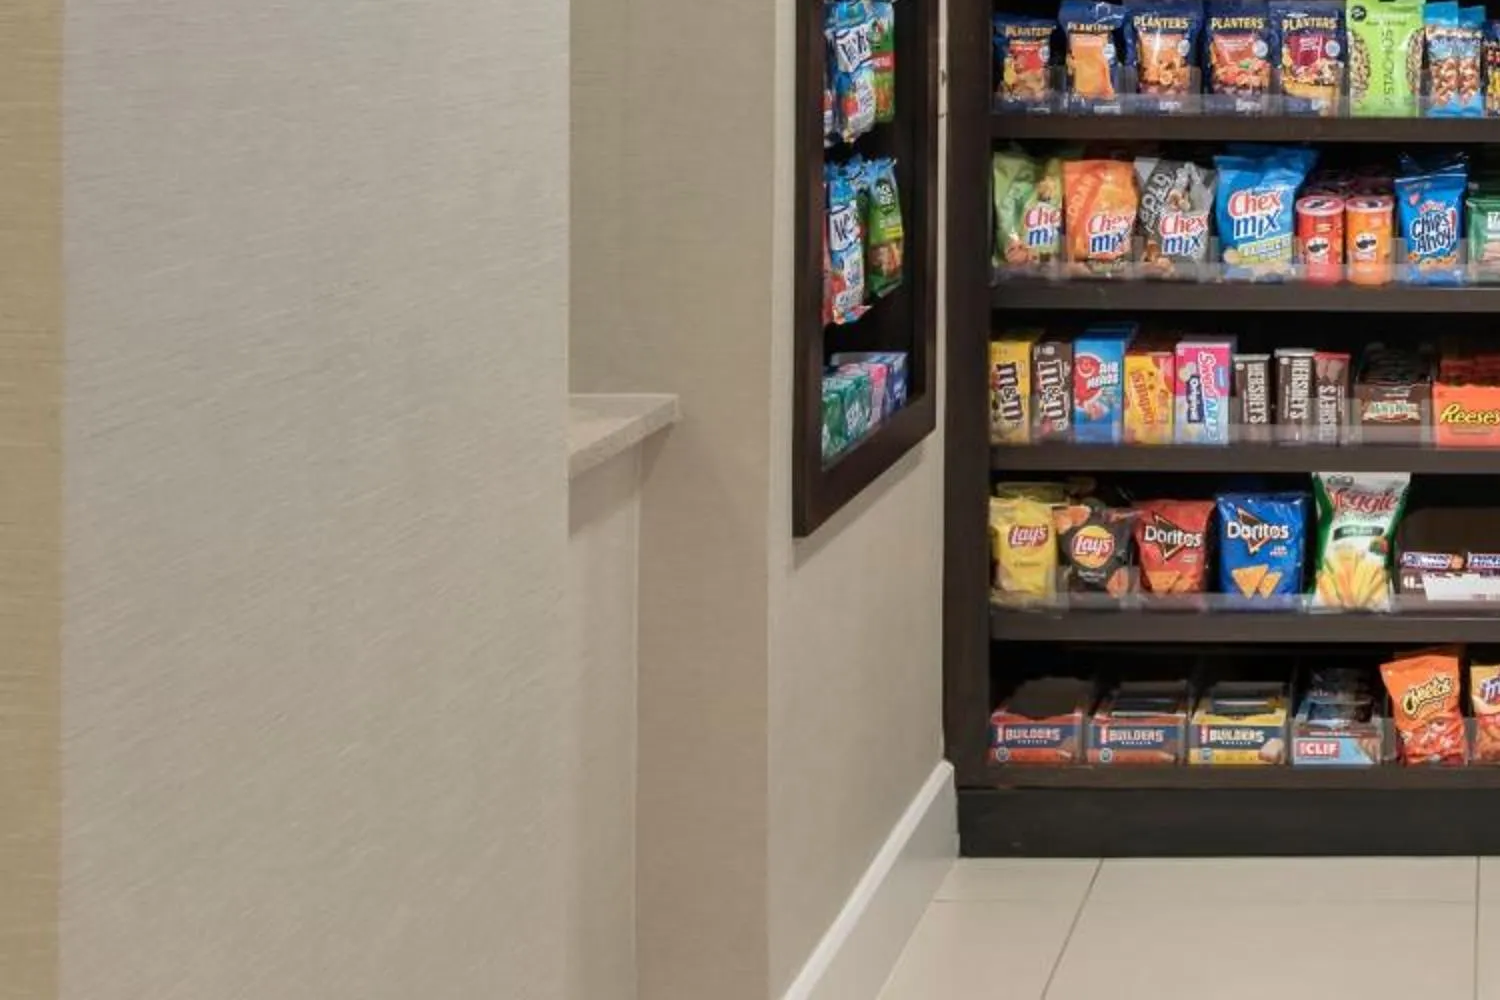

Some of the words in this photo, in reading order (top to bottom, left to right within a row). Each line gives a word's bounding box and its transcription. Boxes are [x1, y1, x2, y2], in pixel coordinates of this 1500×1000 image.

[1133, 15, 1189, 30] PLANTERS
[1211, 16, 1264, 30] PLANTERS
[1282, 17, 1338, 30] PLANTERS
[1229, 191, 1281, 217] Chex
[1025, 207, 1061, 229] Che
[1088, 214, 1135, 235] Chex
[1160, 213, 1208, 235] Chex
[1234, 210, 1280, 238] mix
[1162, 233, 1201, 255] mix
[1247, 363, 1267, 424] HERSHEY'S
[1290, 359, 1312, 420] HERSHEY'S
[1011, 525, 1048, 546] Lay's
[1144, 524, 1202, 548] Doritos
[1227, 521, 1289, 540] Doritos
[1075, 534, 1113, 556] Lay's
[1005, 727, 1061, 740] BUILDERS
[1109, 728, 1165, 742] BUILDERS
[1209, 728, 1265, 742] BUILDERS
[1305, 742, 1338, 755] CLIF
